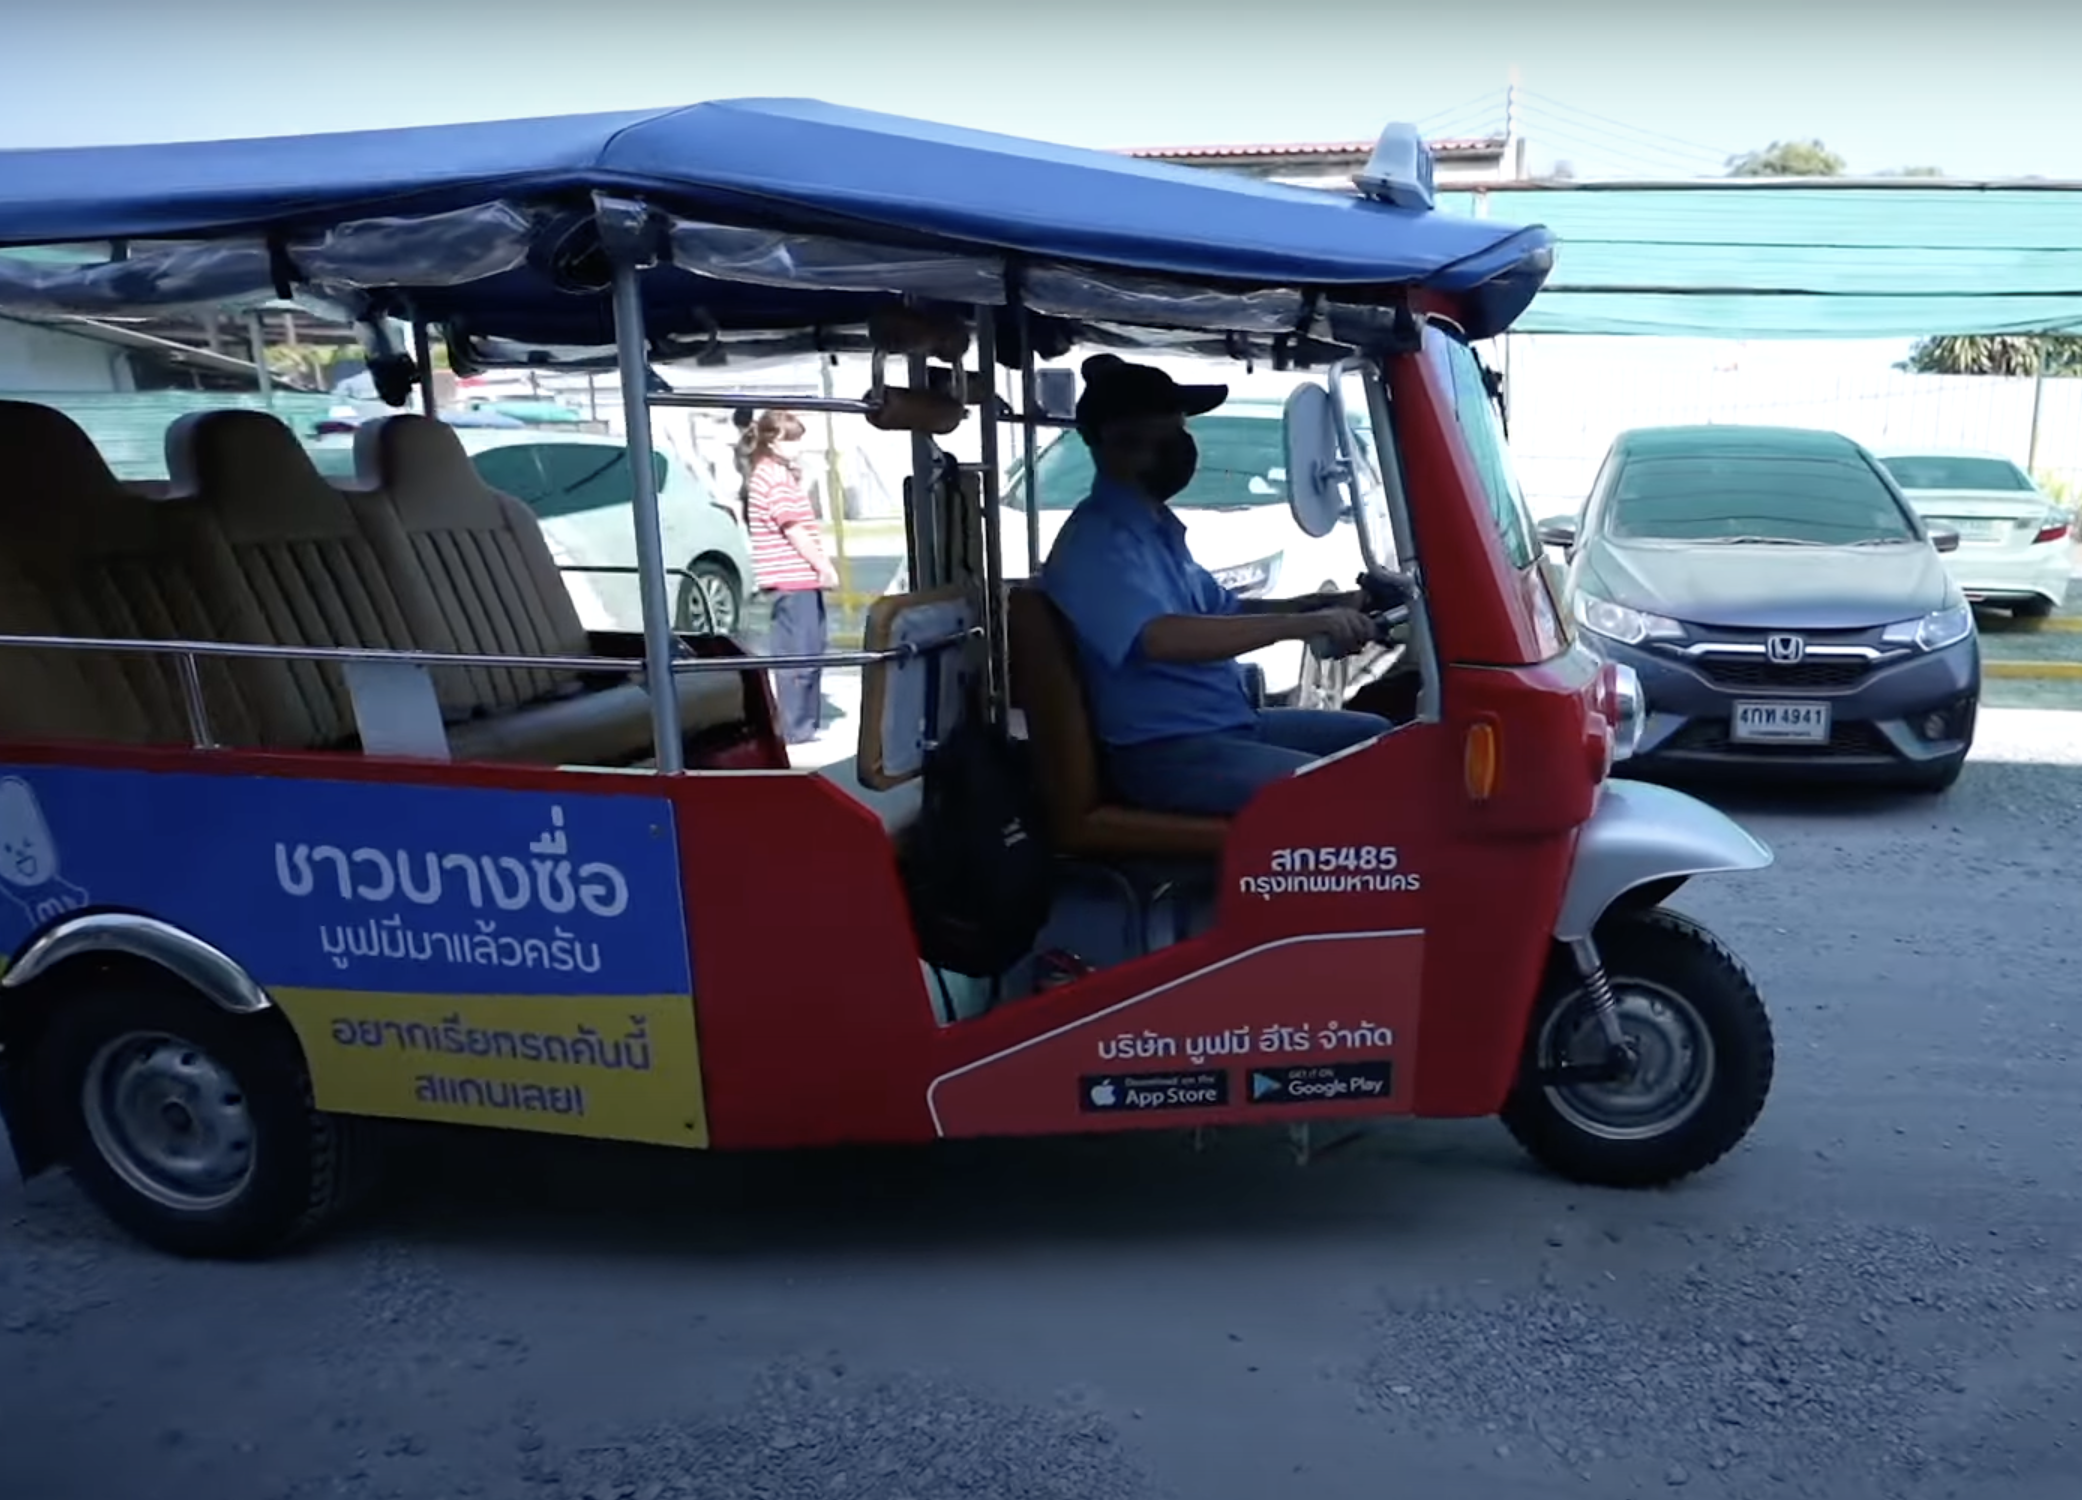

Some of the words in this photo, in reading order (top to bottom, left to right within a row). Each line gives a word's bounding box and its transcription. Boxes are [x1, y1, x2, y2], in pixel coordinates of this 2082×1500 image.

[1781, 708, 1822, 724] 4941
[274, 805, 629, 917] ชาวบางซื่อ
[1240, 873, 1421, 901] กรุงเทพมหานคร
[319, 913, 601, 973] มูฟมีมาแล้วครับ
[331, 1013, 651, 1070] อยากเรียกรถคันนี้
[1097, 1029, 1177, 1060] บริษัท
[1185, 1025, 1250, 1065] มูฟมี
[1258, 1023, 1310, 1052] ฮีโร่
[1317, 1020, 1394, 1050] จำกัด
[414, 1074, 585, 1116] สแกนเลย!
[1125, 1089, 1165, 1108] App
[1166, 1087, 1218, 1104] Store
[1288, 1079, 1348, 1098] Google
[1350, 1076, 1384, 1095] Play
